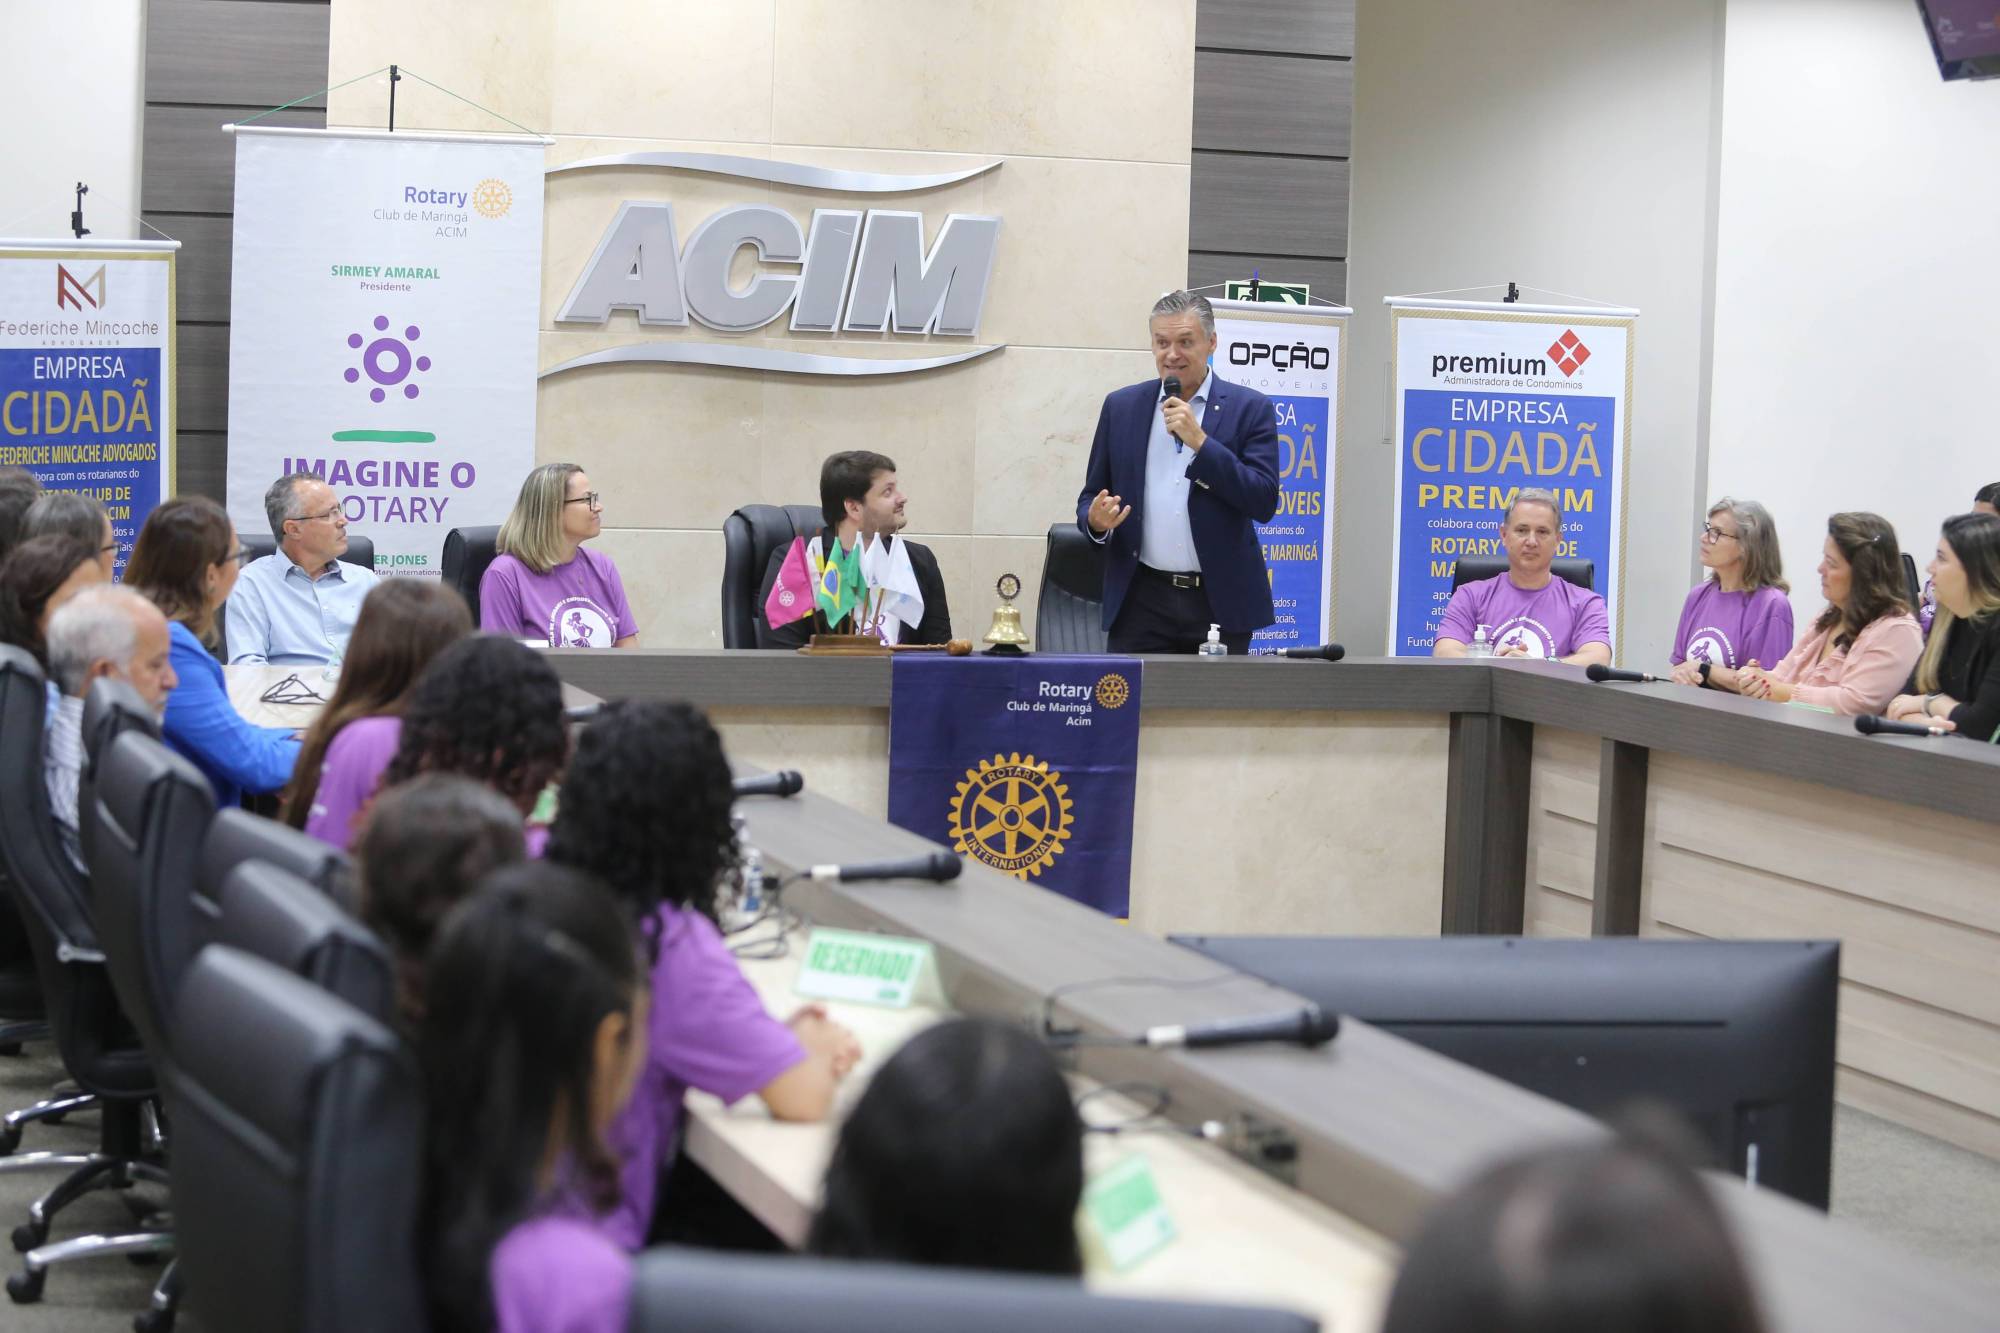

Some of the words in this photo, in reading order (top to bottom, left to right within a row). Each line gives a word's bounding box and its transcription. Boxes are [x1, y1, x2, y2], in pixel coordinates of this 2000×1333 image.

[405, 186, 467, 208] Rotary
[374, 208, 400, 220] Club
[404, 210, 417, 221] de
[435, 226, 467, 238] ACIM
[331, 264, 381, 278] SIRMEY
[384, 266, 440, 279] AMARAL
[554, 200, 1003, 335] ACIM
[360, 281, 411, 292] Presidente
[86, 320, 159, 335] Mincache
[34, 356, 126, 379] EMPRESA
[1432, 352, 1546, 377] premium
[1444, 375, 1509, 387] Administradora
[1512, 377, 1524, 387] de
[3, 378, 152, 435] CIDADÃ
[1451, 398, 1568, 424] EMPRESA
[52, 444, 100, 464] MINCACHE
[102, 443, 156, 462] ADVOGADOS
[1412, 422, 1602, 477] CIDADÃ
[34, 471, 54, 481] bora
[57, 472, 75, 481] com
[77, 472, 86, 480] os
[88, 469, 128, 480] rotarianos
[129, 468, 139, 478] do
[450, 462, 476, 488] O
[116, 486, 131, 500] DE
[1275, 484, 1320, 515] ÓVEIS
[105, 506, 130, 520] CIM
[342, 495, 449, 523] OTARY
[1258, 525, 1294, 534] rotarianos
[1295, 525, 1305, 534] do
[1428, 518, 1473, 528] colabora
[1476, 520, 1498, 529] com
[1570, 521, 1583, 532] do
[1270, 540, 1318, 560] MARINGÁ
[1431, 537, 1500, 555] ROTARY
[1556, 541, 1577, 557] DE
[390, 555, 427, 567] JONES
[1275, 613, 1296, 624] ociais,
[1289, 629, 1299, 639] da
[1039, 681, 1092, 700] Rotary
[1007, 701, 1030, 711] Club
[1032, 701, 1046, 712] de
[1049, 702, 1092, 714] Maringá
[1066, 716, 1091, 726] Acim
[987, 766, 1039, 782] ROTARY
[967, 837, 1054, 870] INTERNATIONAL
